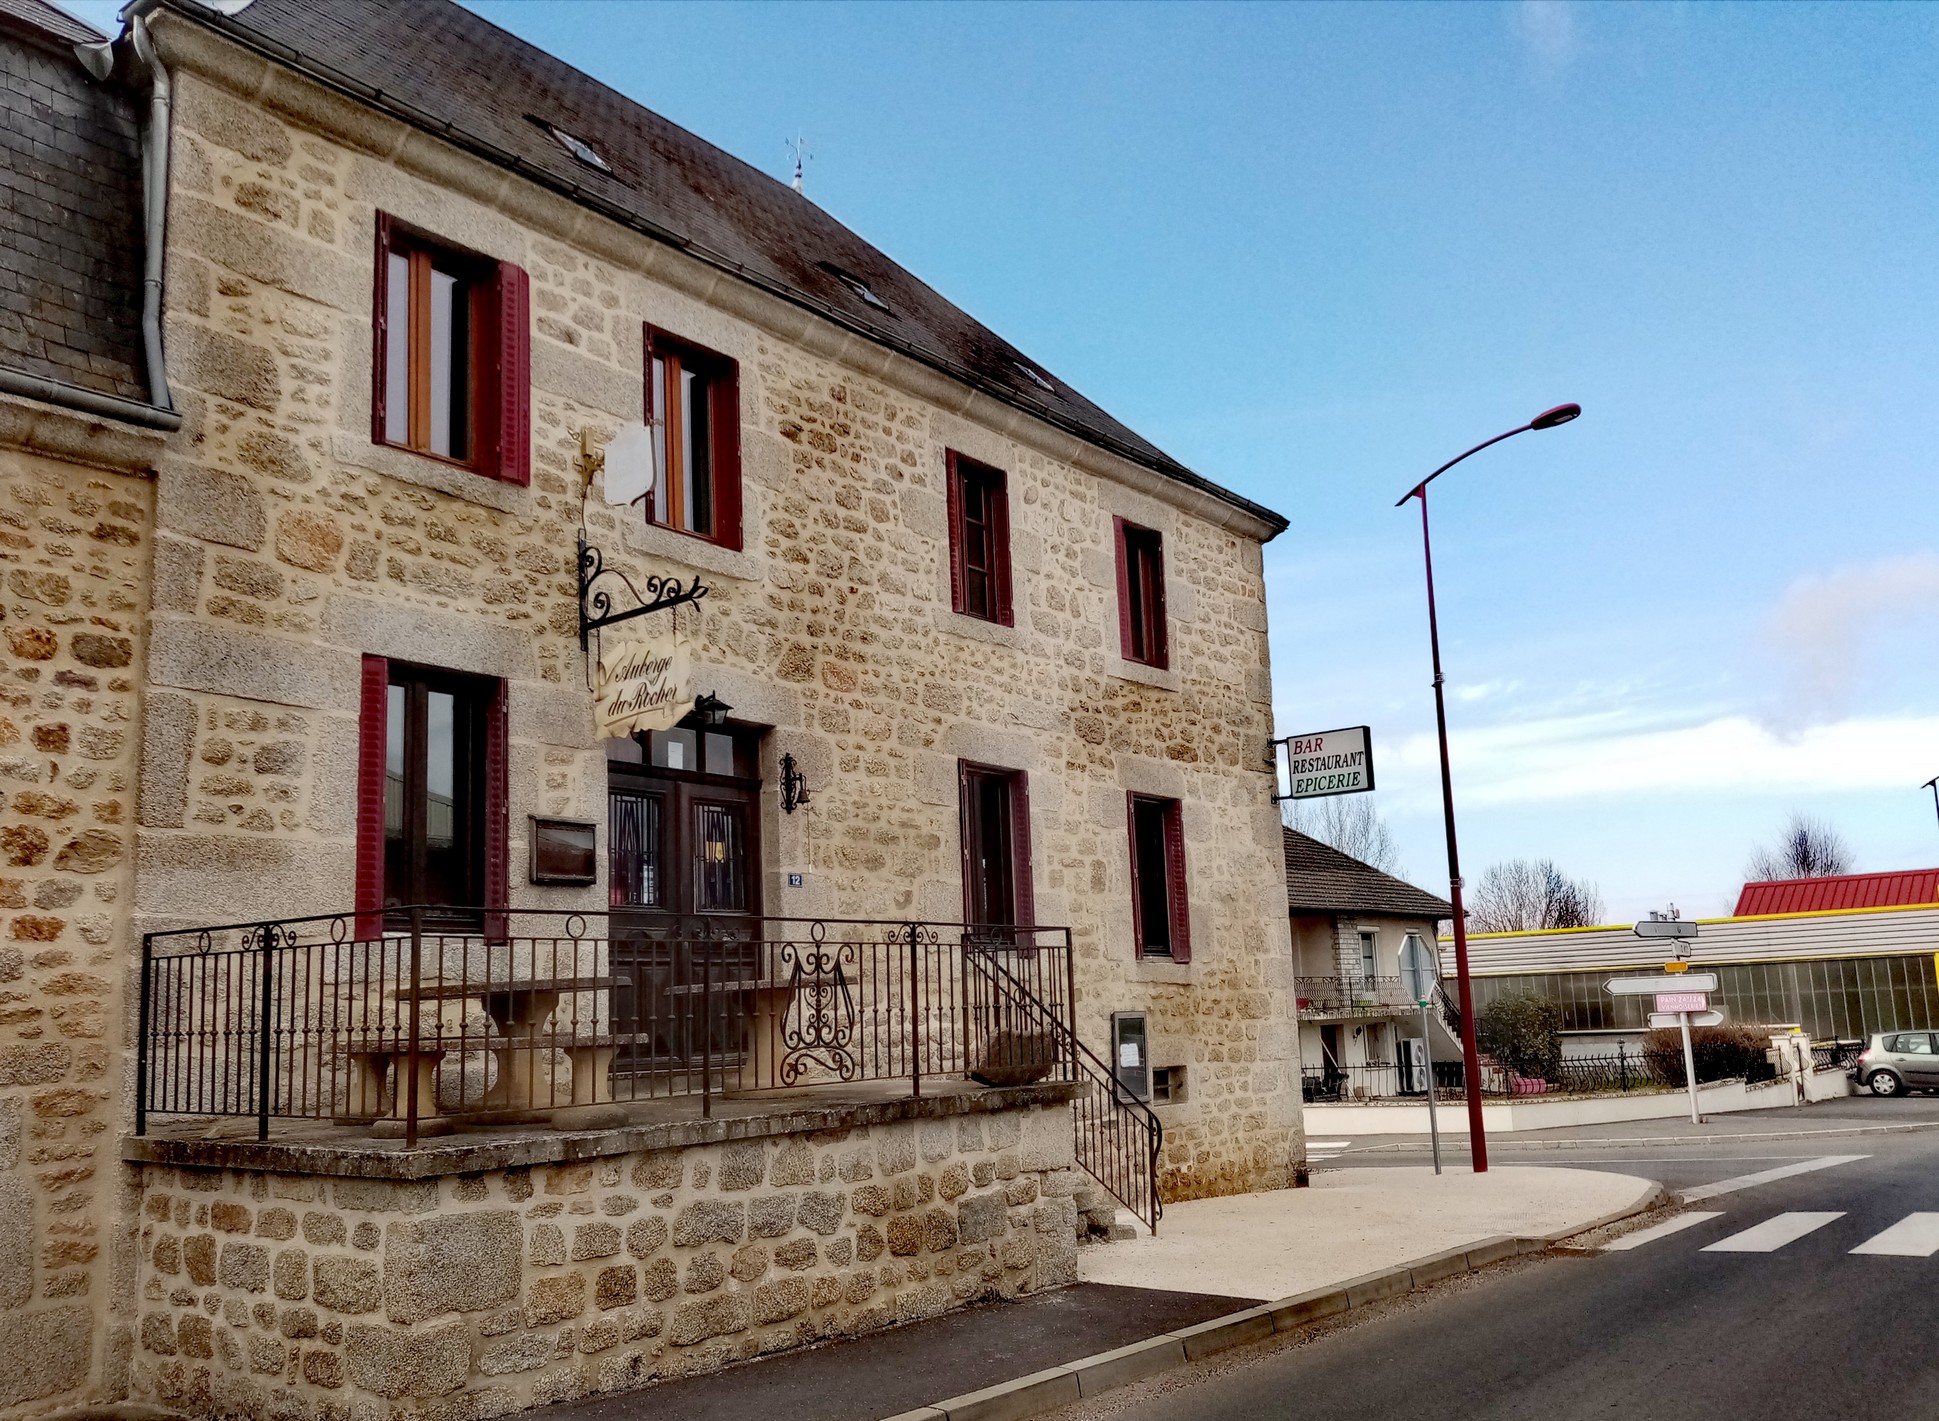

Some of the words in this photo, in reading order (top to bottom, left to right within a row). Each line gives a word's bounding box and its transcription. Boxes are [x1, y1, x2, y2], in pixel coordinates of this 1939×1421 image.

[615, 650, 673, 686] Auberge
[608, 688, 627, 717] du
[628, 676, 678, 711] Rocher
[1293, 738, 1324, 755] BAR
[1293, 751, 1364, 774] RESTAURANT
[1295, 771, 1361, 793] EPICERIE
[791, 876, 800, 885] 12
